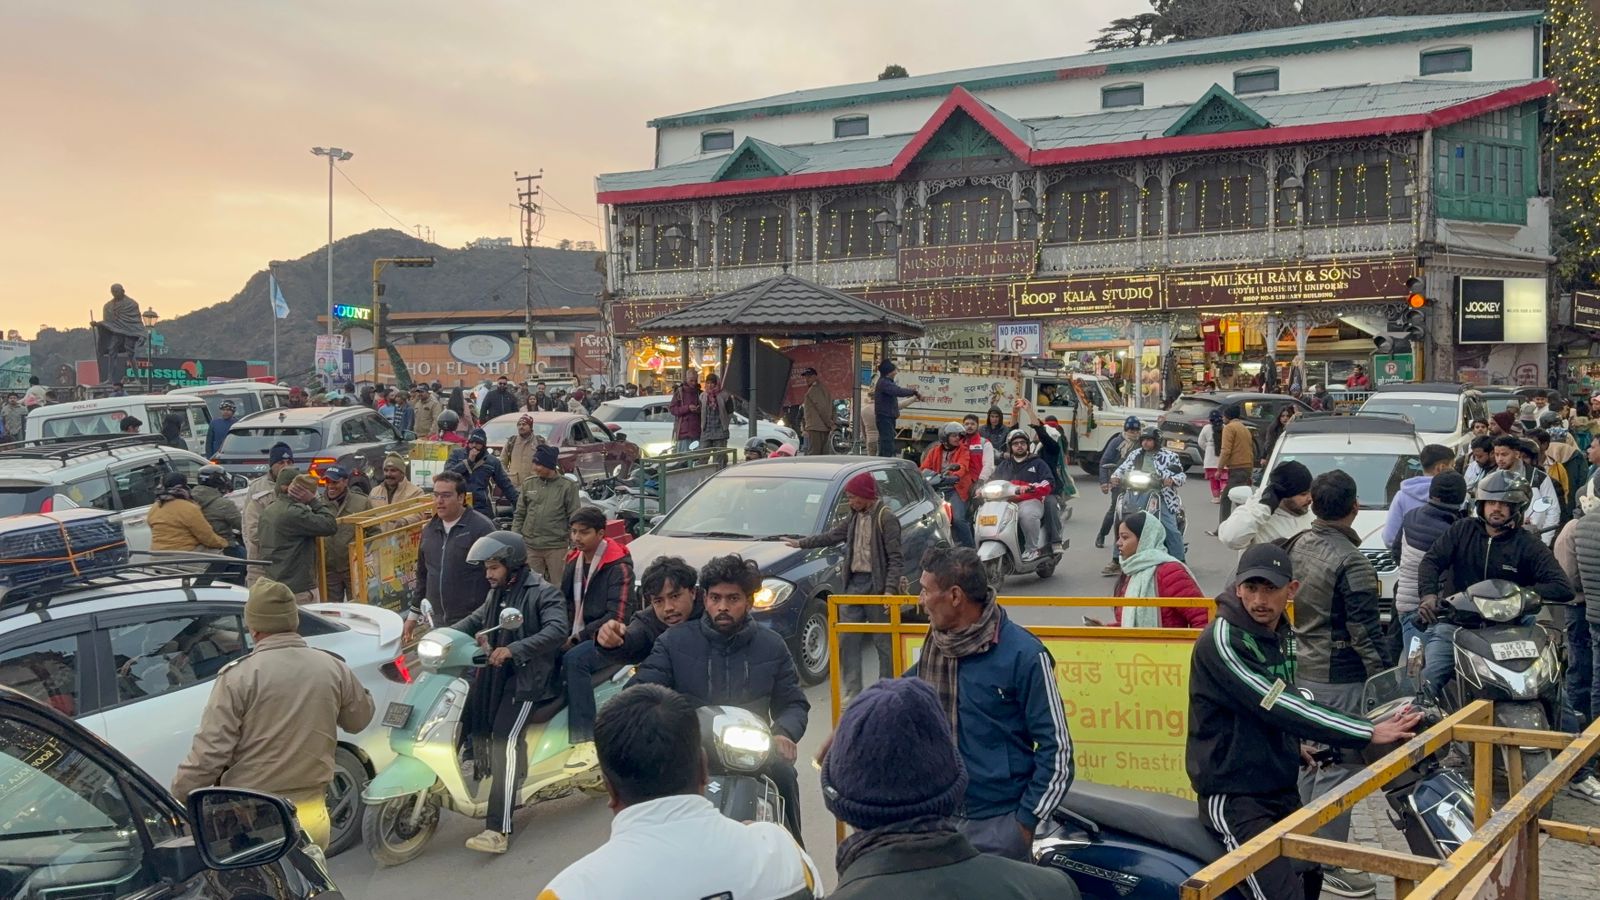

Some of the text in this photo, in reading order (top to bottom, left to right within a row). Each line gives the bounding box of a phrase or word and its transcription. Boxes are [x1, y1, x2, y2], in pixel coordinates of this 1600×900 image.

[904, 251, 1028, 270] MUSSOORIE LIBRARY
[1211, 272, 1263, 287] MILKHI
[1268, 270, 1301, 283] RAM
[1305, 269, 1316, 282] &
[1320, 267, 1361, 281] SONS
[1021, 286, 1153, 306] ROOP KALA STUDIO
[1465, 302, 1500, 313] JOCKEY
[1000, 325, 1038, 335] NO PARKING
[72, 403, 97, 411] POLICE
[1116, 653, 1182, 695] पुलिस
[1116, 751, 1182, 771] Shastri
